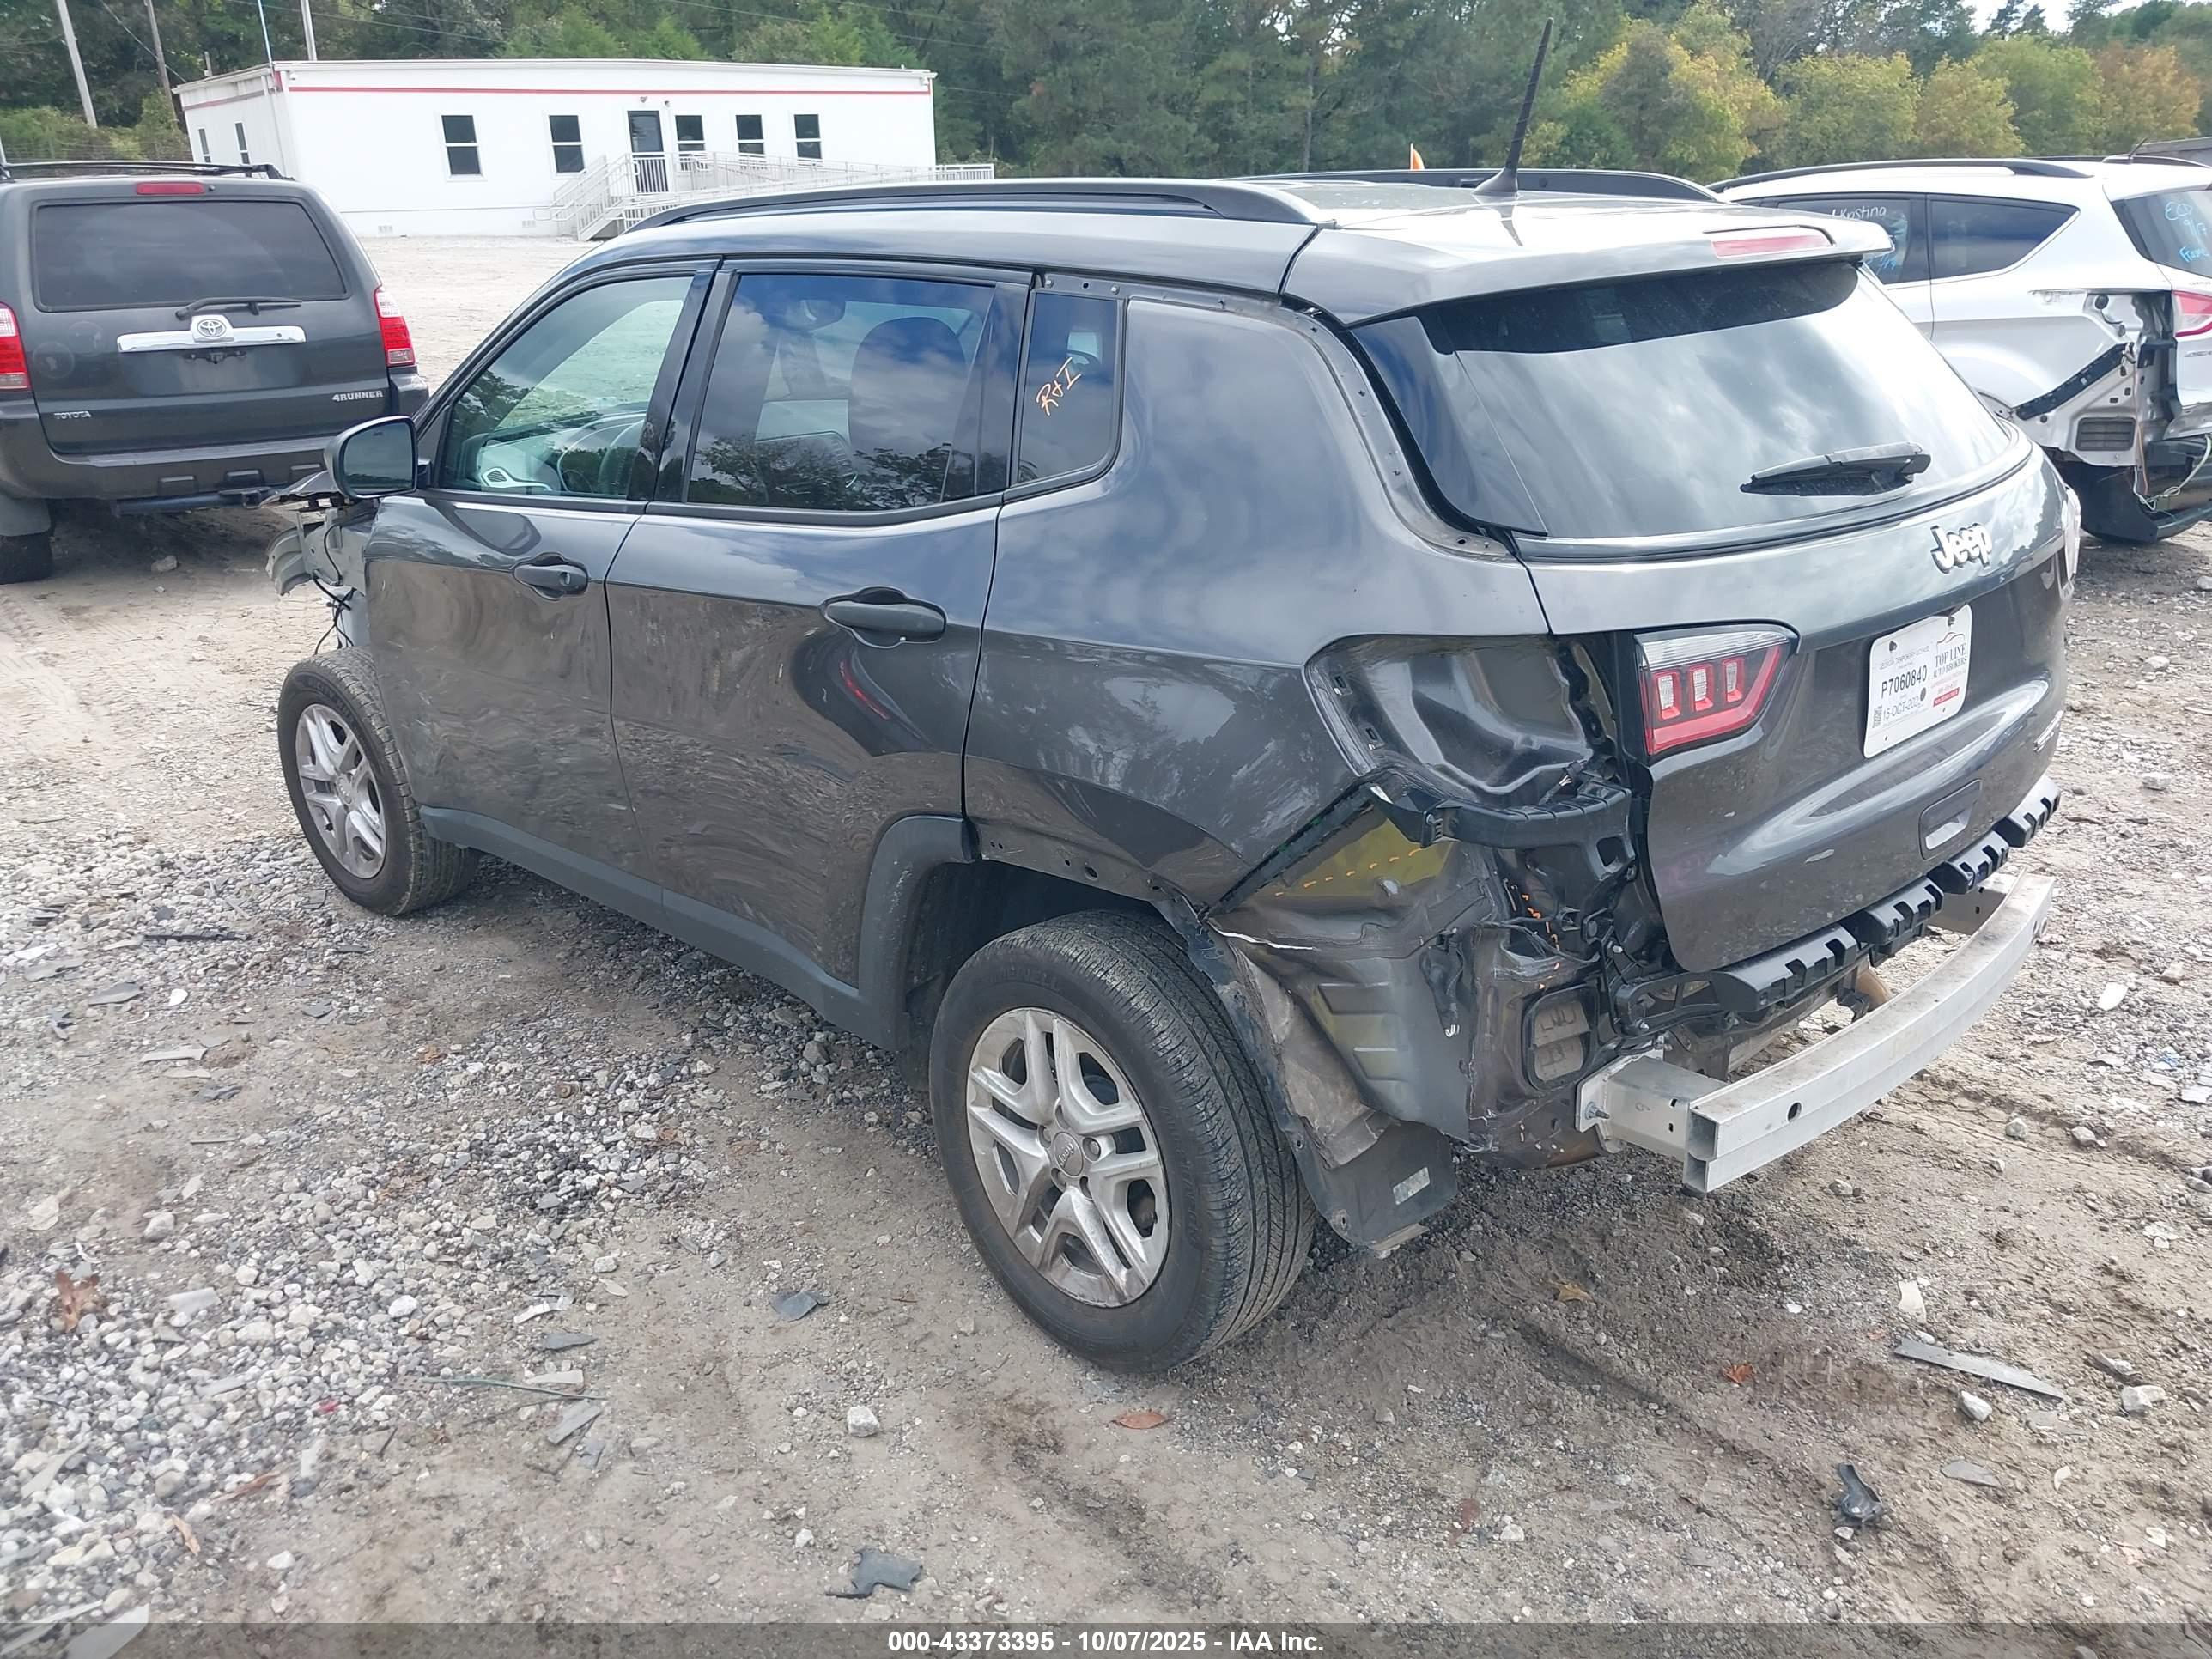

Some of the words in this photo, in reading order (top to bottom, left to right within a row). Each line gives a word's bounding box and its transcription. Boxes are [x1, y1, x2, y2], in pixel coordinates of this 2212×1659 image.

[332, 389, 384, 403] 4RUNNER
[53, 410, 92, 420] TOYOTA
[1930, 522, 1992, 574] Jeep
[1935, 651, 1949, 668] TOP
[1949, 642, 1966, 661] LINE
[1881, 664, 1928, 699] P7060840
